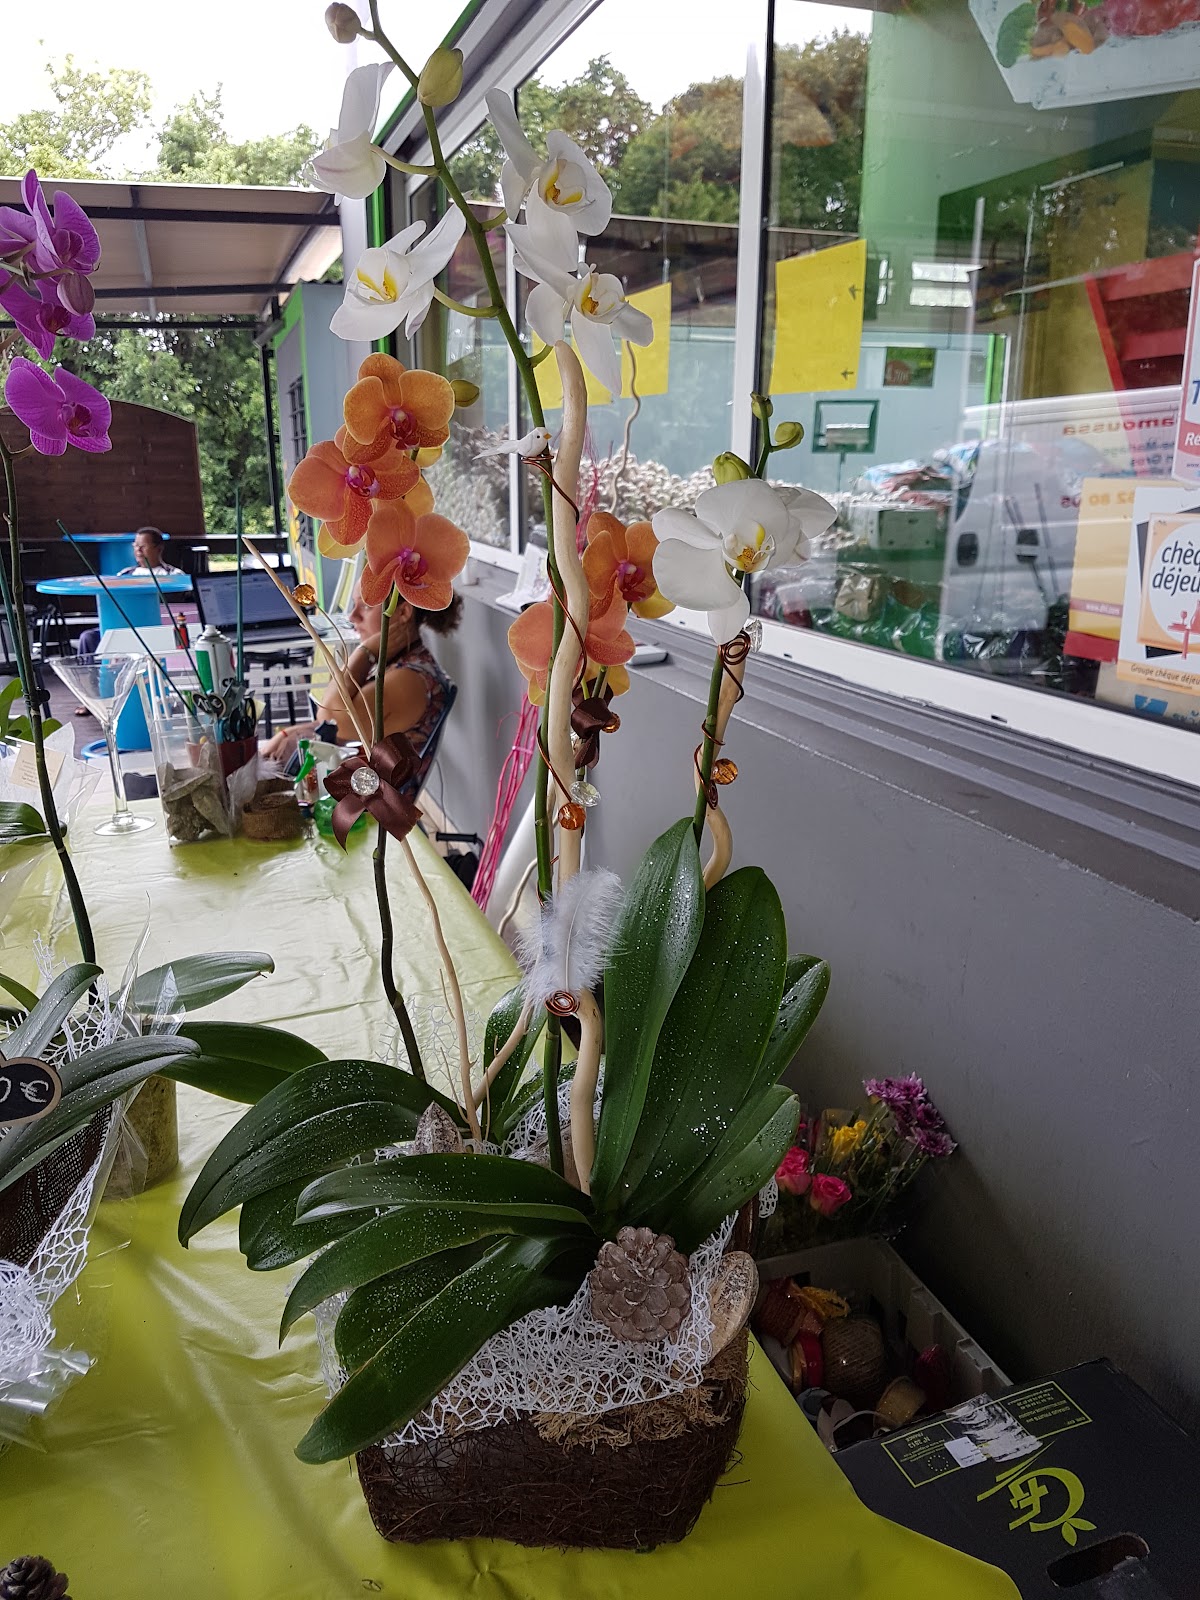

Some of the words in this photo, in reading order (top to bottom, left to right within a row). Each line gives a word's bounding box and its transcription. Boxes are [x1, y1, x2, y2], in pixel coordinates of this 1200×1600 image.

[1152, 566, 1200, 597] déjeu
[1130, 663, 1154, 676] Groupe
[1155, 669, 1179, 681] chèque
